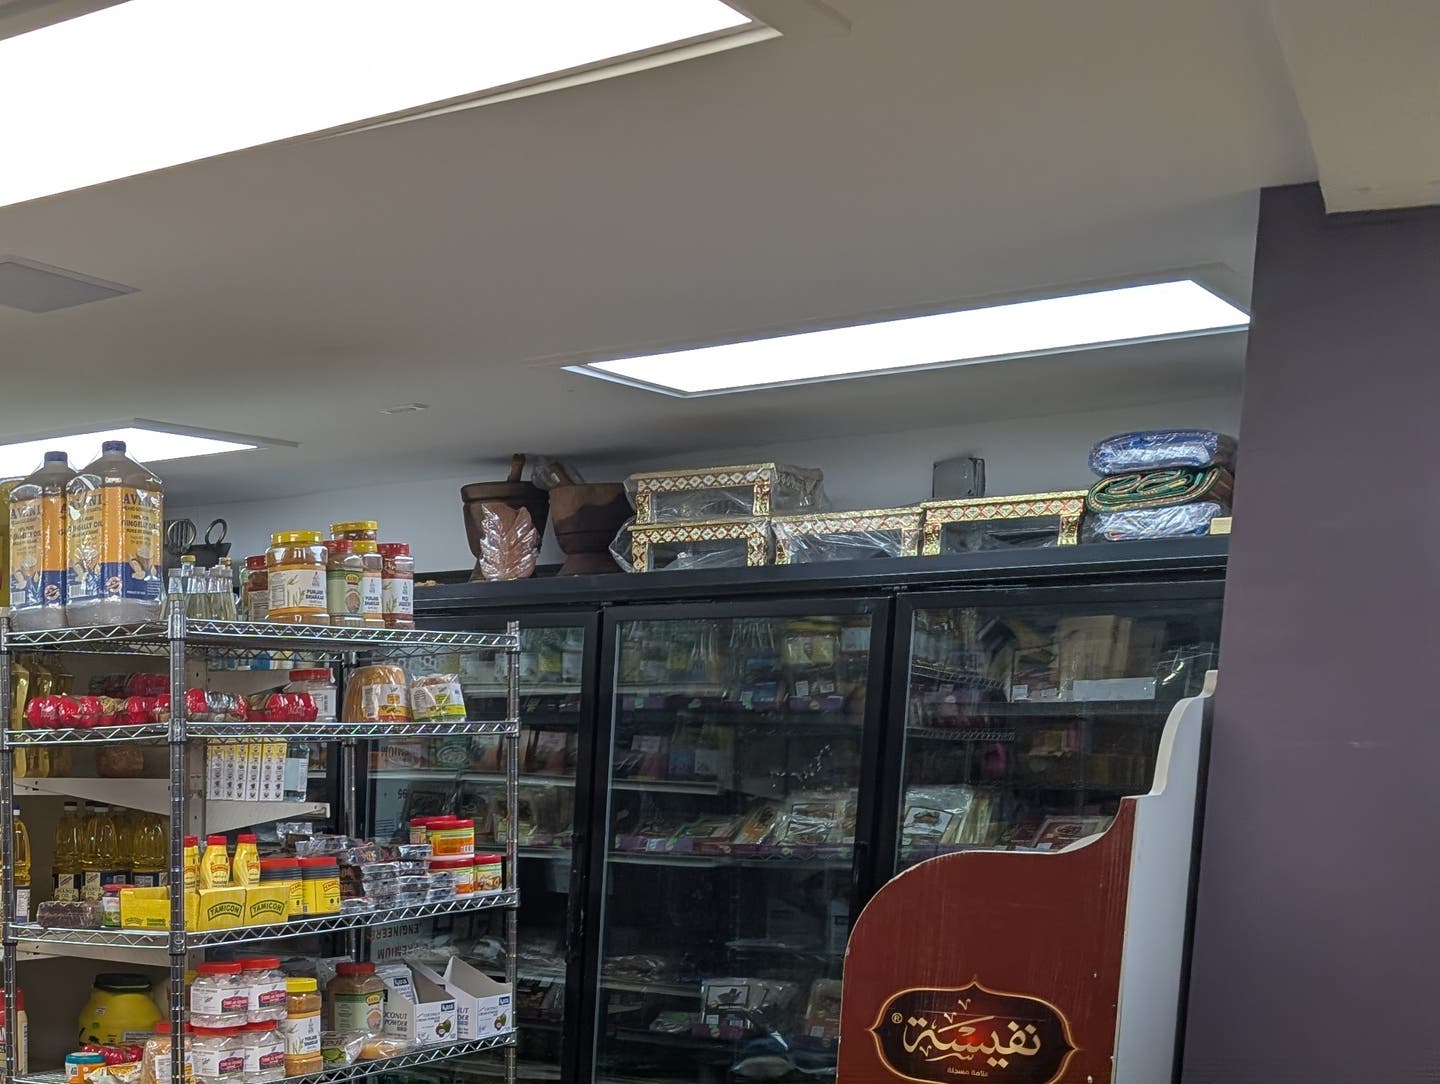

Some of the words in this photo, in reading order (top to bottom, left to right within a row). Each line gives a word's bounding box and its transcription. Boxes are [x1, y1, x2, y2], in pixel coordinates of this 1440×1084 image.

[209, 903, 242, 918] TAMICON
[251, 902, 283, 916] TAMICON
[384, 1011, 407, 1020] OCONUT
